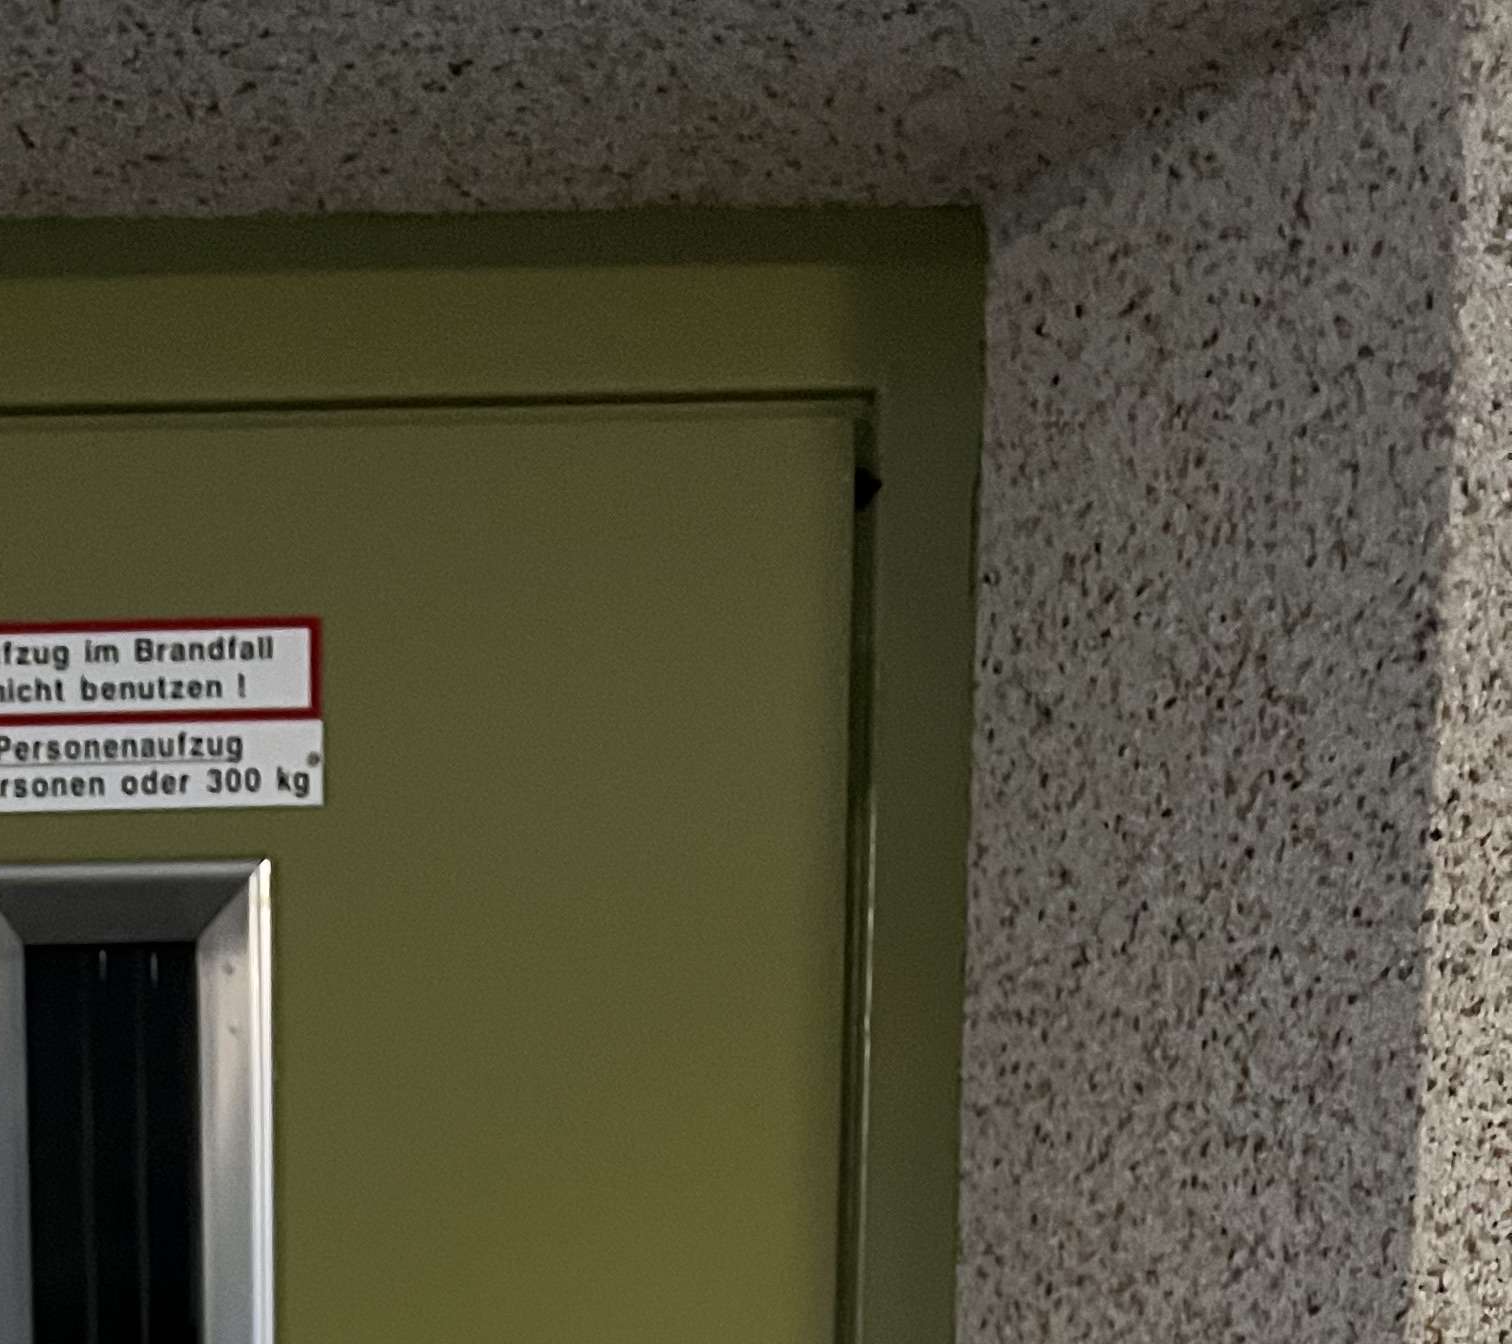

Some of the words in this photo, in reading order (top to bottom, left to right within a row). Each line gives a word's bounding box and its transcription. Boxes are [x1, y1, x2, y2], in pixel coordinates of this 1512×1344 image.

[85, 640, 119, 664] im
[134, 635, 274, 662] Brandfall
[81, 674, 222, 701] benutzen
[238, 673, 246, 698] !
[121, 770, 189, 795] oder
[206, 767, 261, 793] 300
[278, 766, 309, 798] kg
